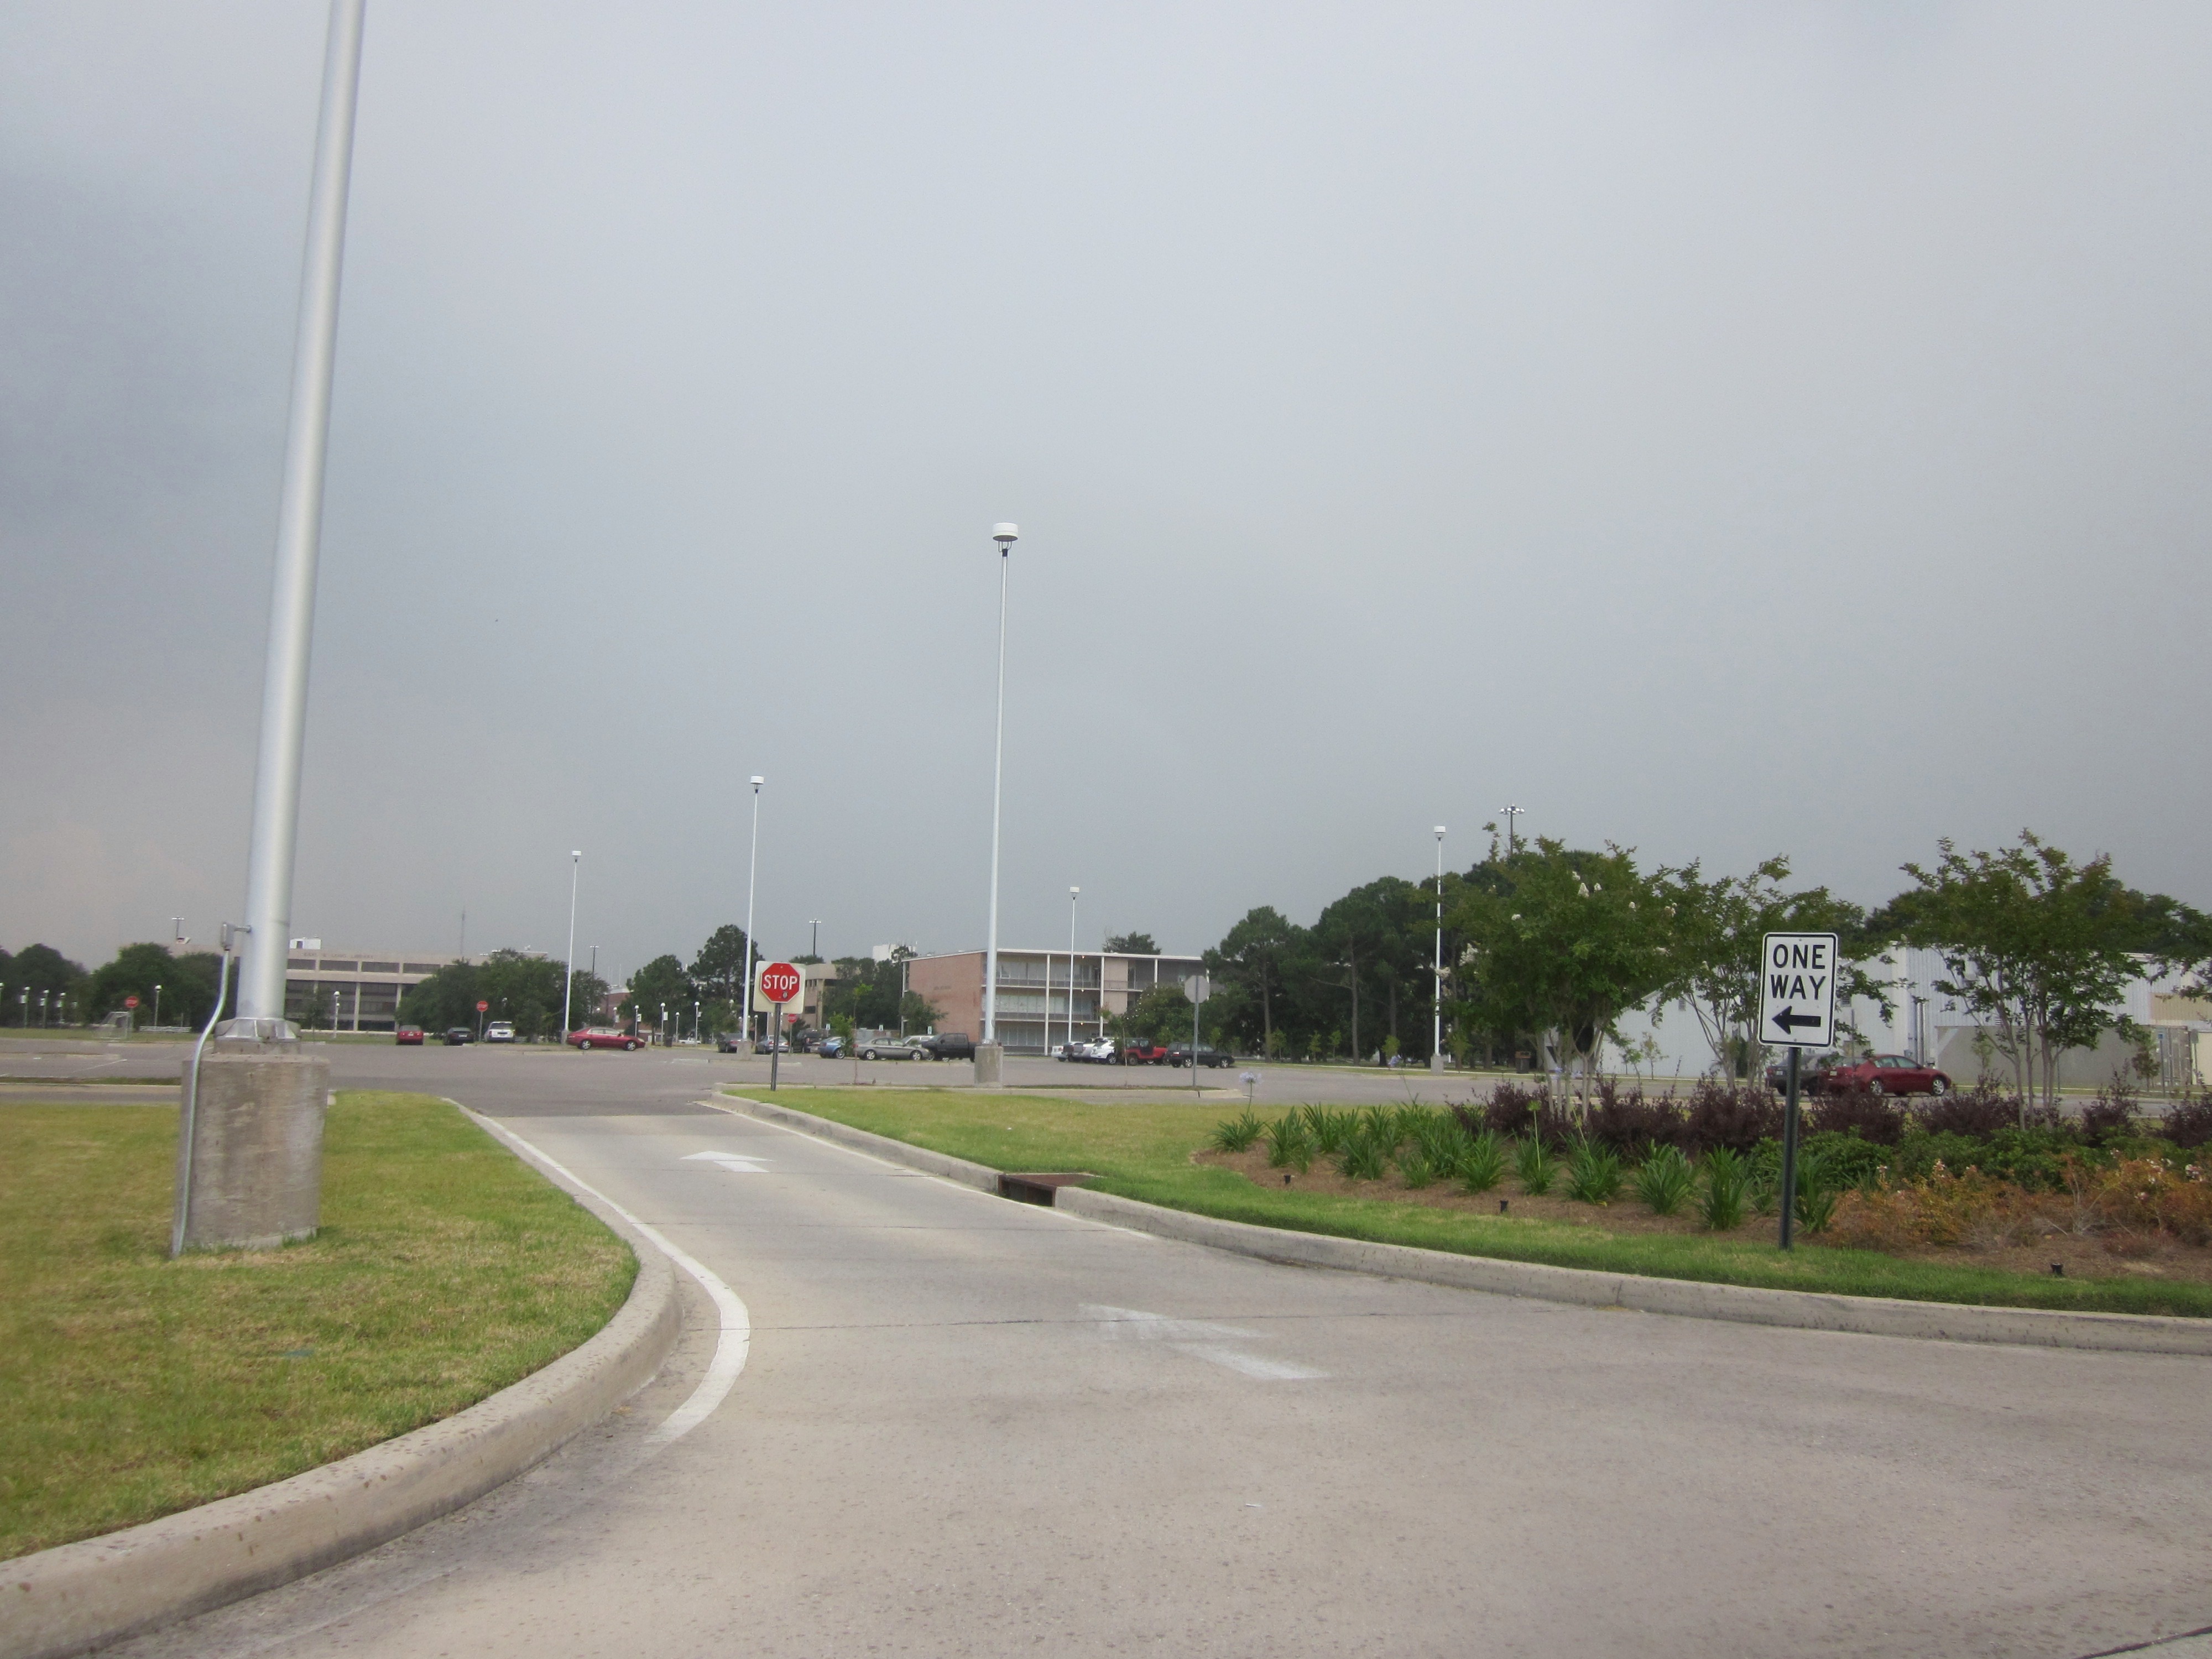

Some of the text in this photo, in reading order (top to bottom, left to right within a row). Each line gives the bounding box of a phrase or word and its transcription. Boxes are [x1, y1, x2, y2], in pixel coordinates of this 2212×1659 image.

[1773, 944, 1825, 969] ONE
[763, 974, 797, 990] STOP
[1770, 974, 1826, 1000] WAY
